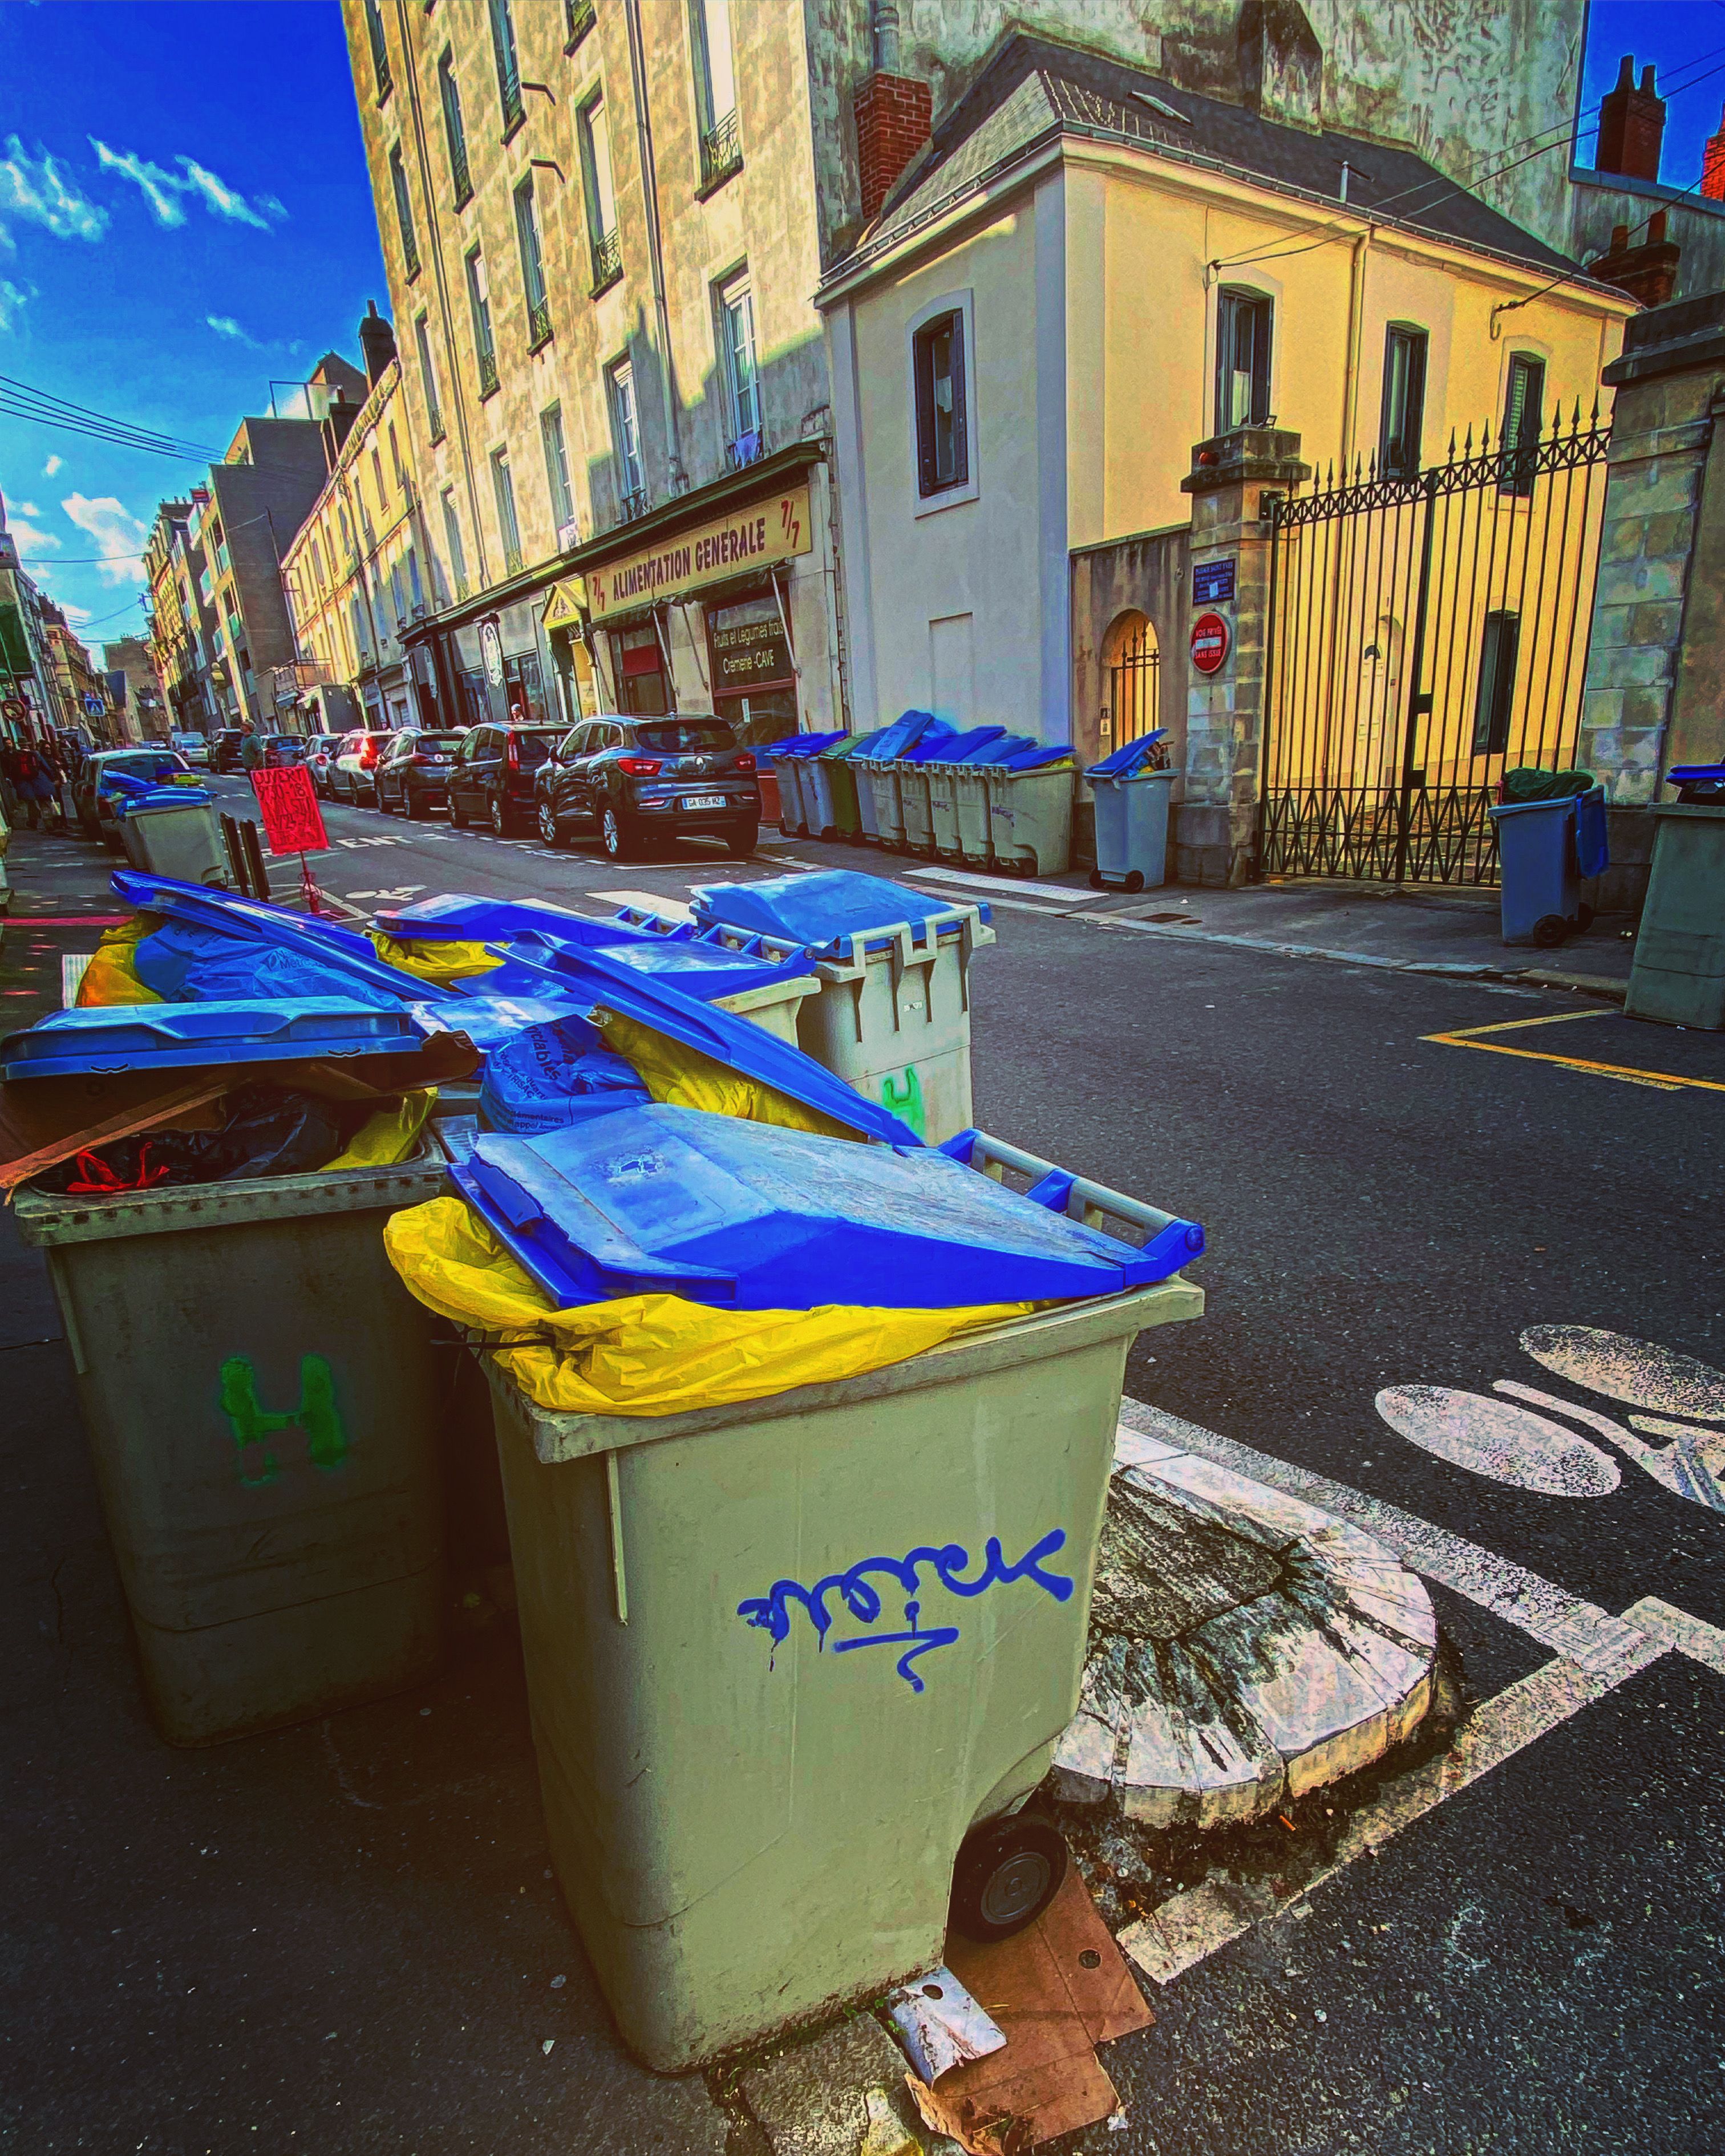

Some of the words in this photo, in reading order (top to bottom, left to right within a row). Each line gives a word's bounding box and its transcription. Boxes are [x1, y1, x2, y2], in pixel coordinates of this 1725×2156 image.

[781, 499, 800, 549] 7/7
[613, 545, 691, 601] ALIMENTATION
[695, 517, 766, 572] GENERALE
[593, 576, 605, 612] 7/7
